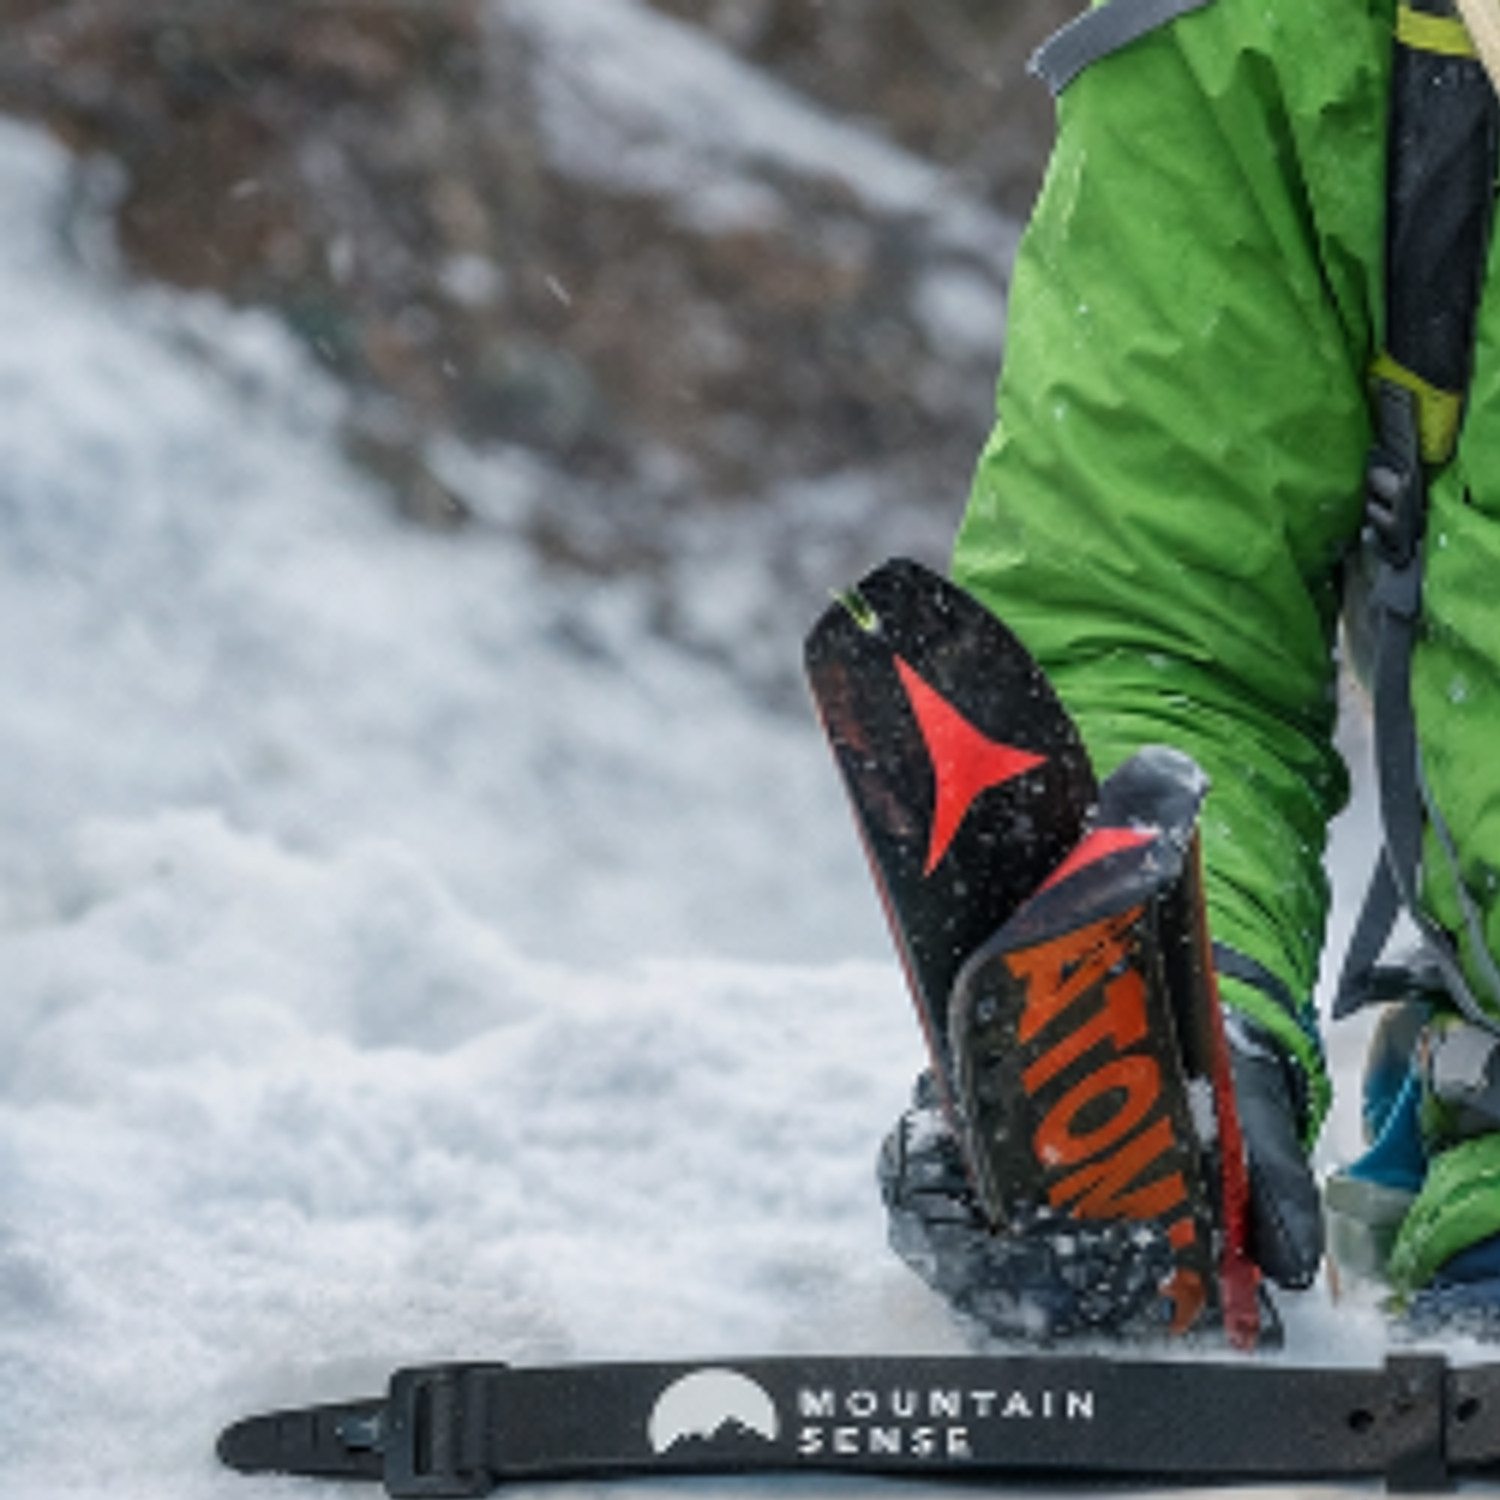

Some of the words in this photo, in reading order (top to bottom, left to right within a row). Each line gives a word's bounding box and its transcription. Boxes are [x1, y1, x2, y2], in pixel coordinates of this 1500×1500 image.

[1002, 903, 1207, 1338] ATOM
[799, 1389, 1096, 1419] MOUNTAIN
[799, 1427, 972, 1456] SENSE
